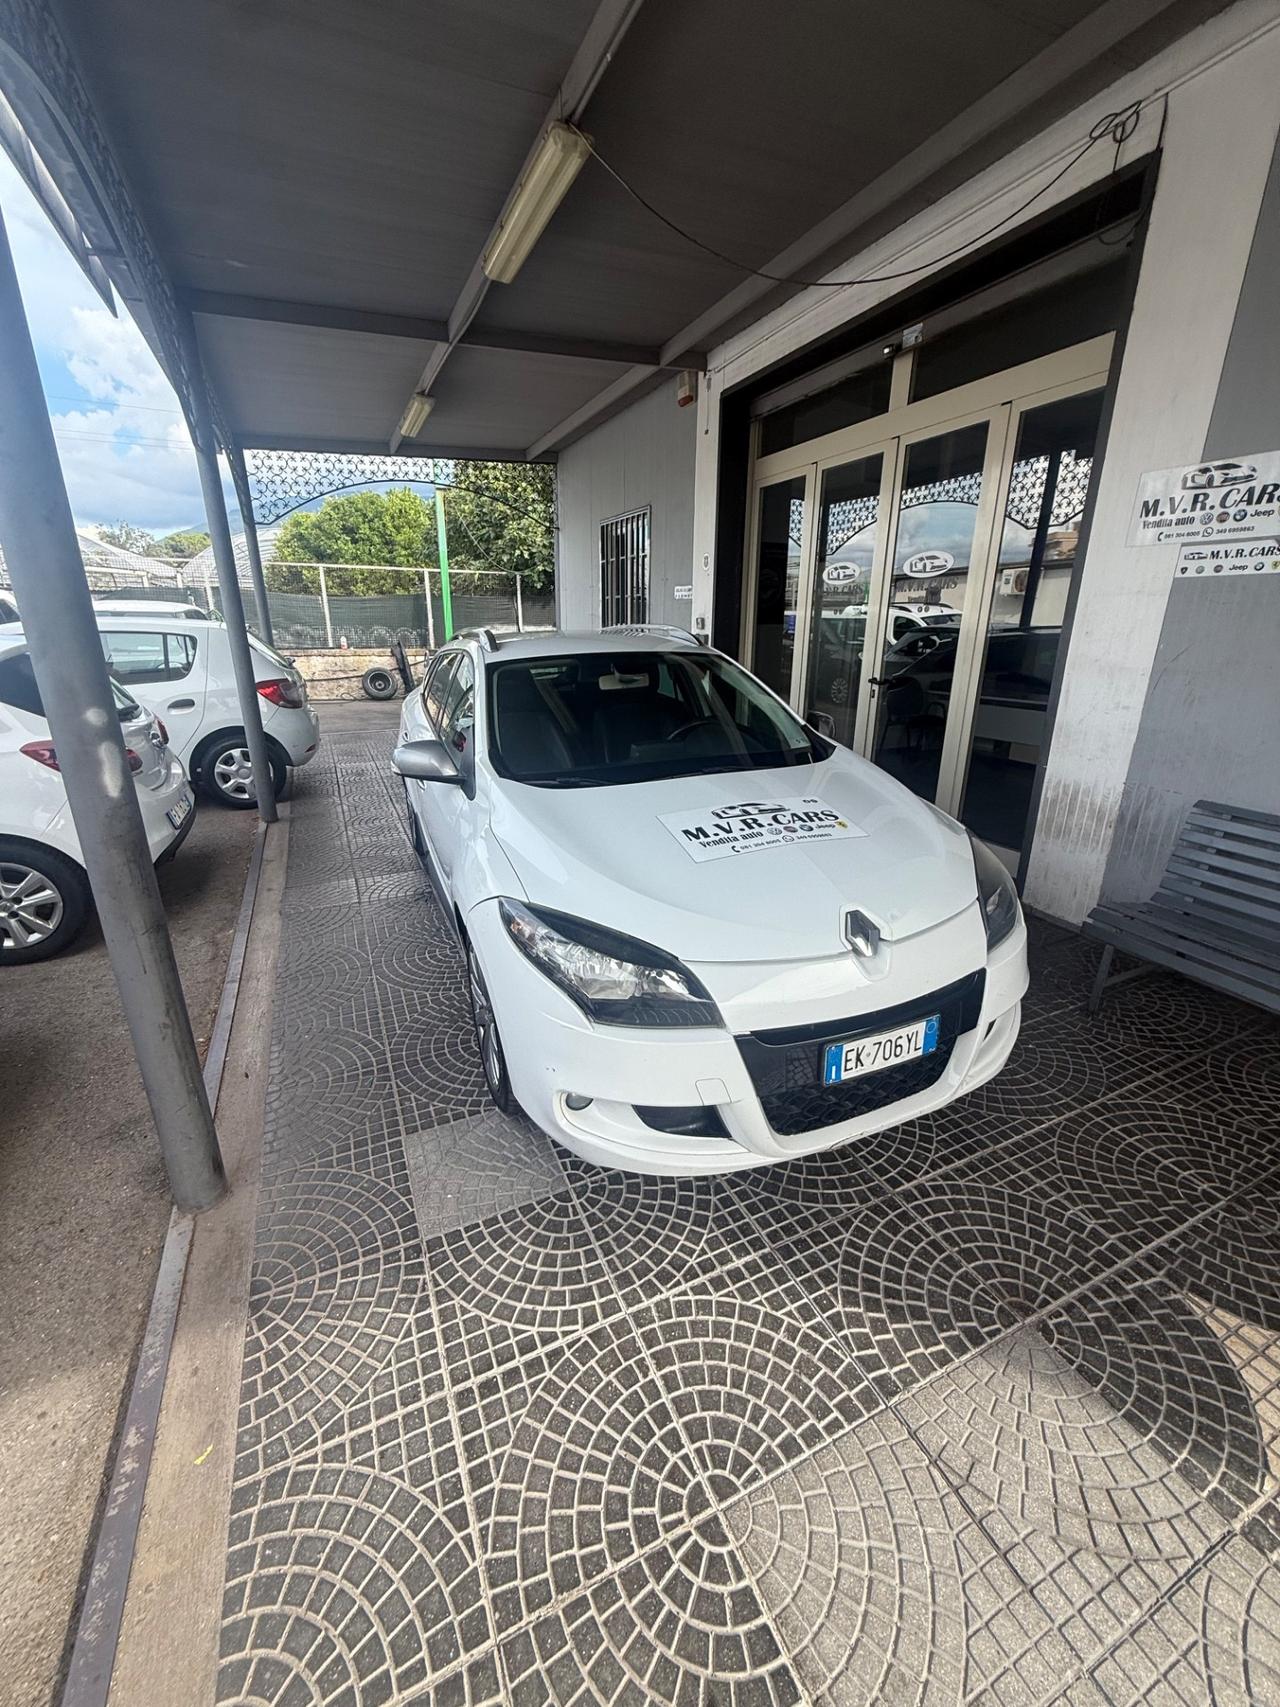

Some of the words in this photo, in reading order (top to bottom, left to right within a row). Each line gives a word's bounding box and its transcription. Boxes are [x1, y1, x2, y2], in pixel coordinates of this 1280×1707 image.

[1140, 483, 1280, 518] M.V.R.CAR
[1142, 518, 1172, 529] Vendita
[1175, 515, 1195, 526] auto
[1250, 509, 1275, 518] Jeep
[698, 834, 740, 849] Vendita
[741, 829, 763, 841] auto
